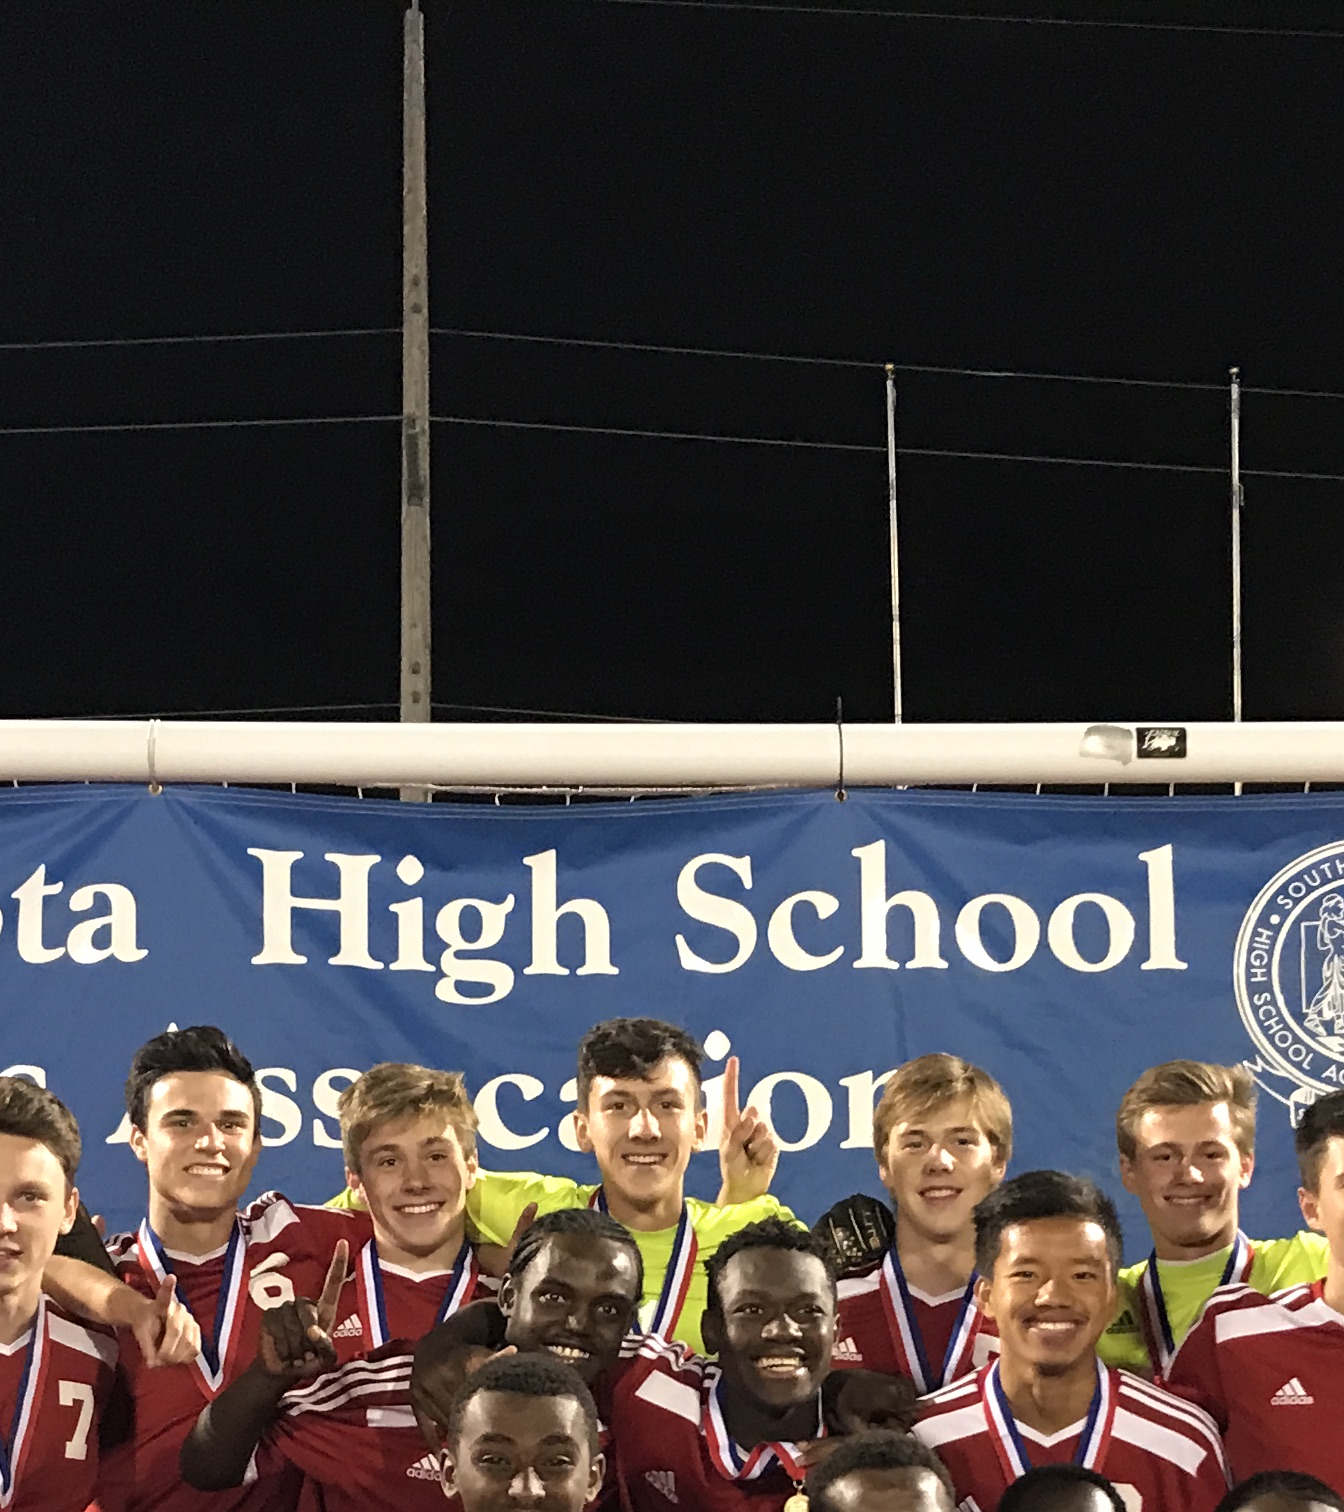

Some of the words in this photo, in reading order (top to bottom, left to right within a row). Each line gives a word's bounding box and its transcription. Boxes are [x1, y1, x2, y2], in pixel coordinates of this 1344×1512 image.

[247, 848, 620, 1006] High
[675, 839, 1188, 974] School
[1250, 927, 1274, 983] HIGH
[1253, 992, 1316, 1070] SCHOOL
[58, 1379, 96, 1461] 7
[1270, 1394, 1315, 1406] adidas
